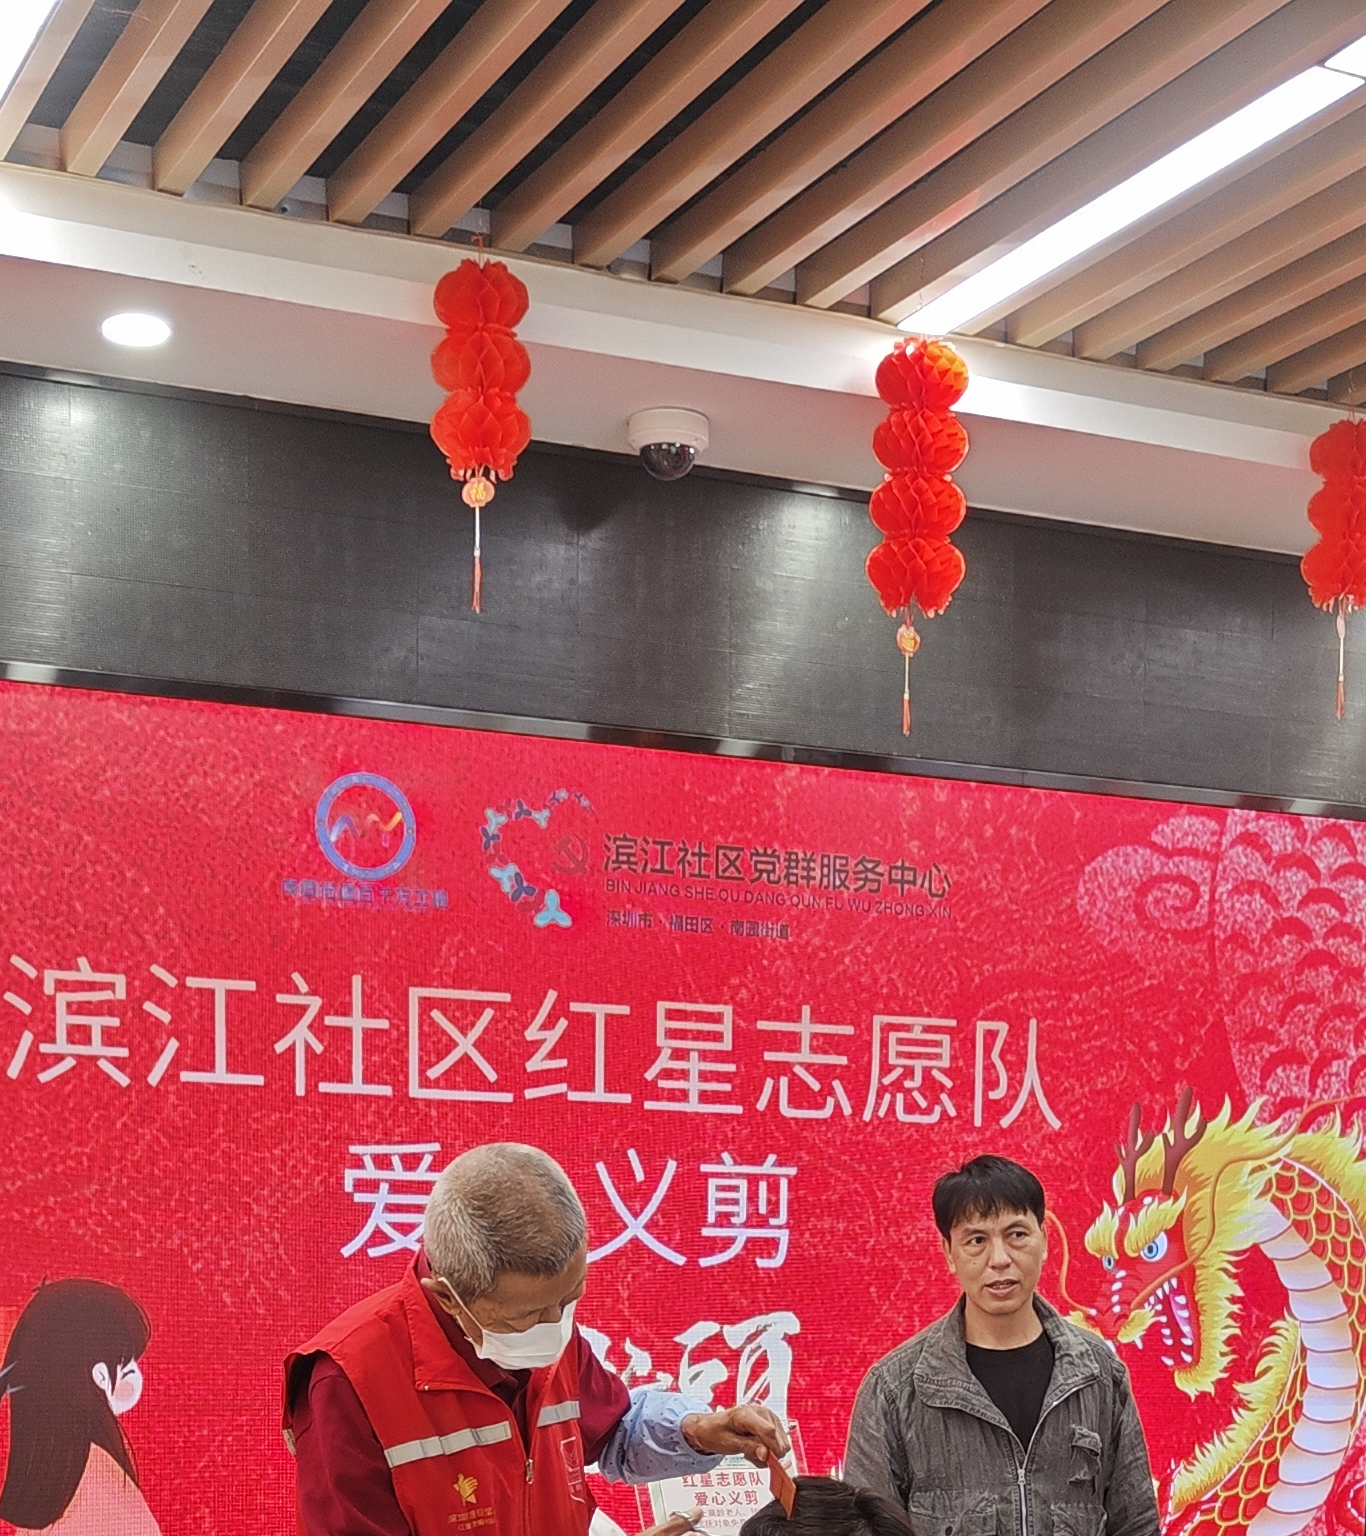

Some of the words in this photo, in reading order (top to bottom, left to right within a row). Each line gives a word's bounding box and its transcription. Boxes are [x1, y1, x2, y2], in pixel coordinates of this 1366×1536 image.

[603, 832, 953, 899] 滨江社区党群服务中心
[605, 878, 631, 894] BIN
[635, 880, 681, 899] JIANG
[684, 884, 714, 901] SHE
[744, 890, 786, 907] DANG
[790, 894, 822, 910] QUN
[874, 900, 925, 918] ZHONG
[928, 903, 952, 920] XIN
[4, 953, 1064, 1131] 滨江社区红星志愿队
[339, 1141, 799, 1270] 爱义剪
[682, 1471, 765, 1488] 红星志愿队
[694, 1489, 760, 1507] 爱心义剪
